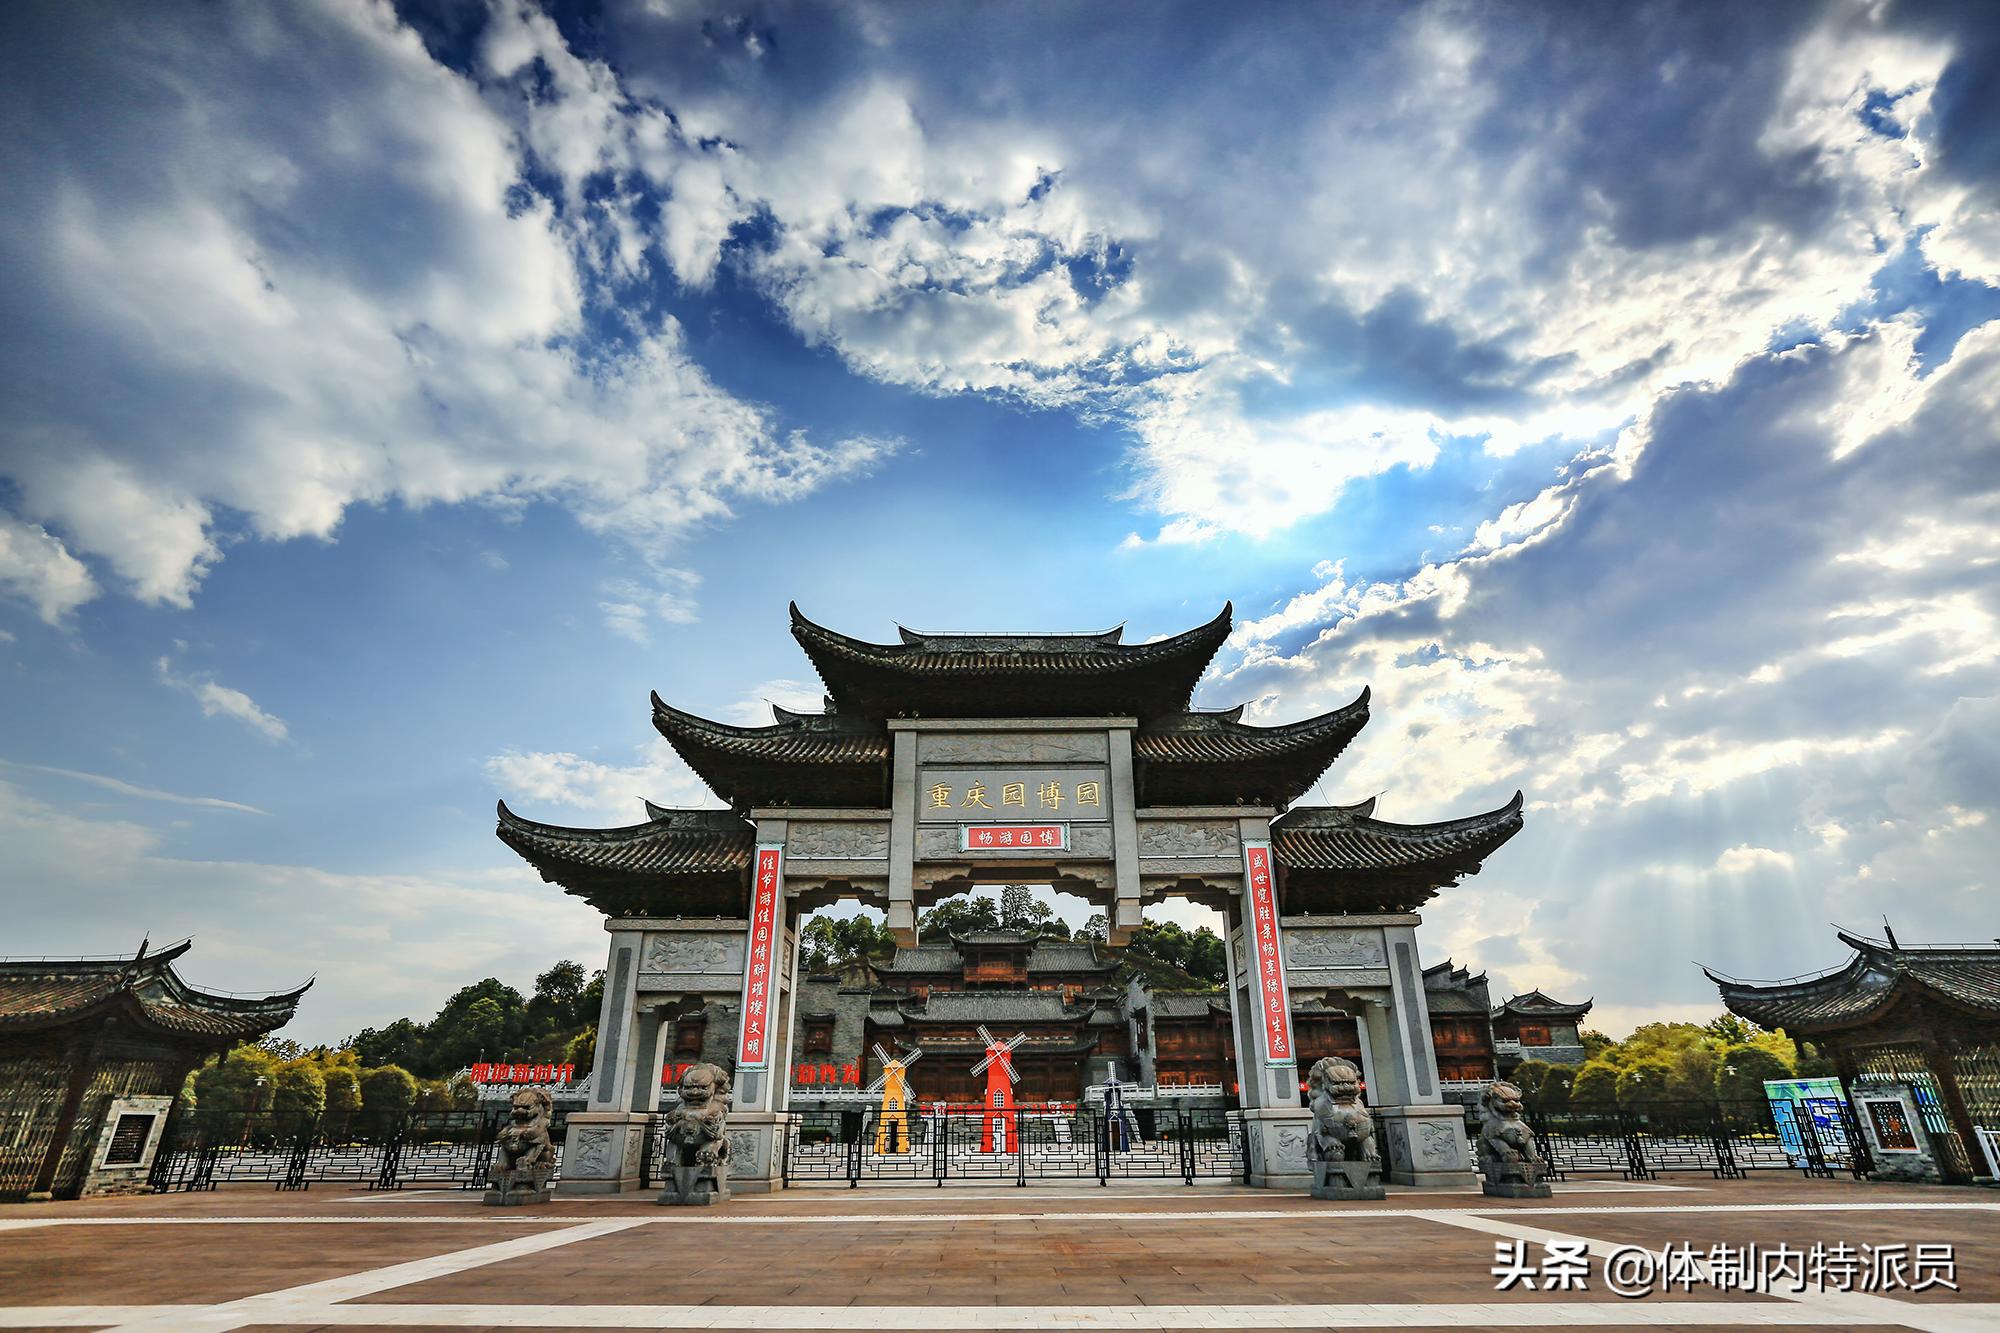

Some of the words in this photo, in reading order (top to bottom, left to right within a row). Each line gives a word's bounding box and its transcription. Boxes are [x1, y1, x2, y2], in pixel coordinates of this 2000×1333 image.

[927, 780, 1101, 810] 重庆园博园
[978, 829, 1055, 846] 畅游园博
